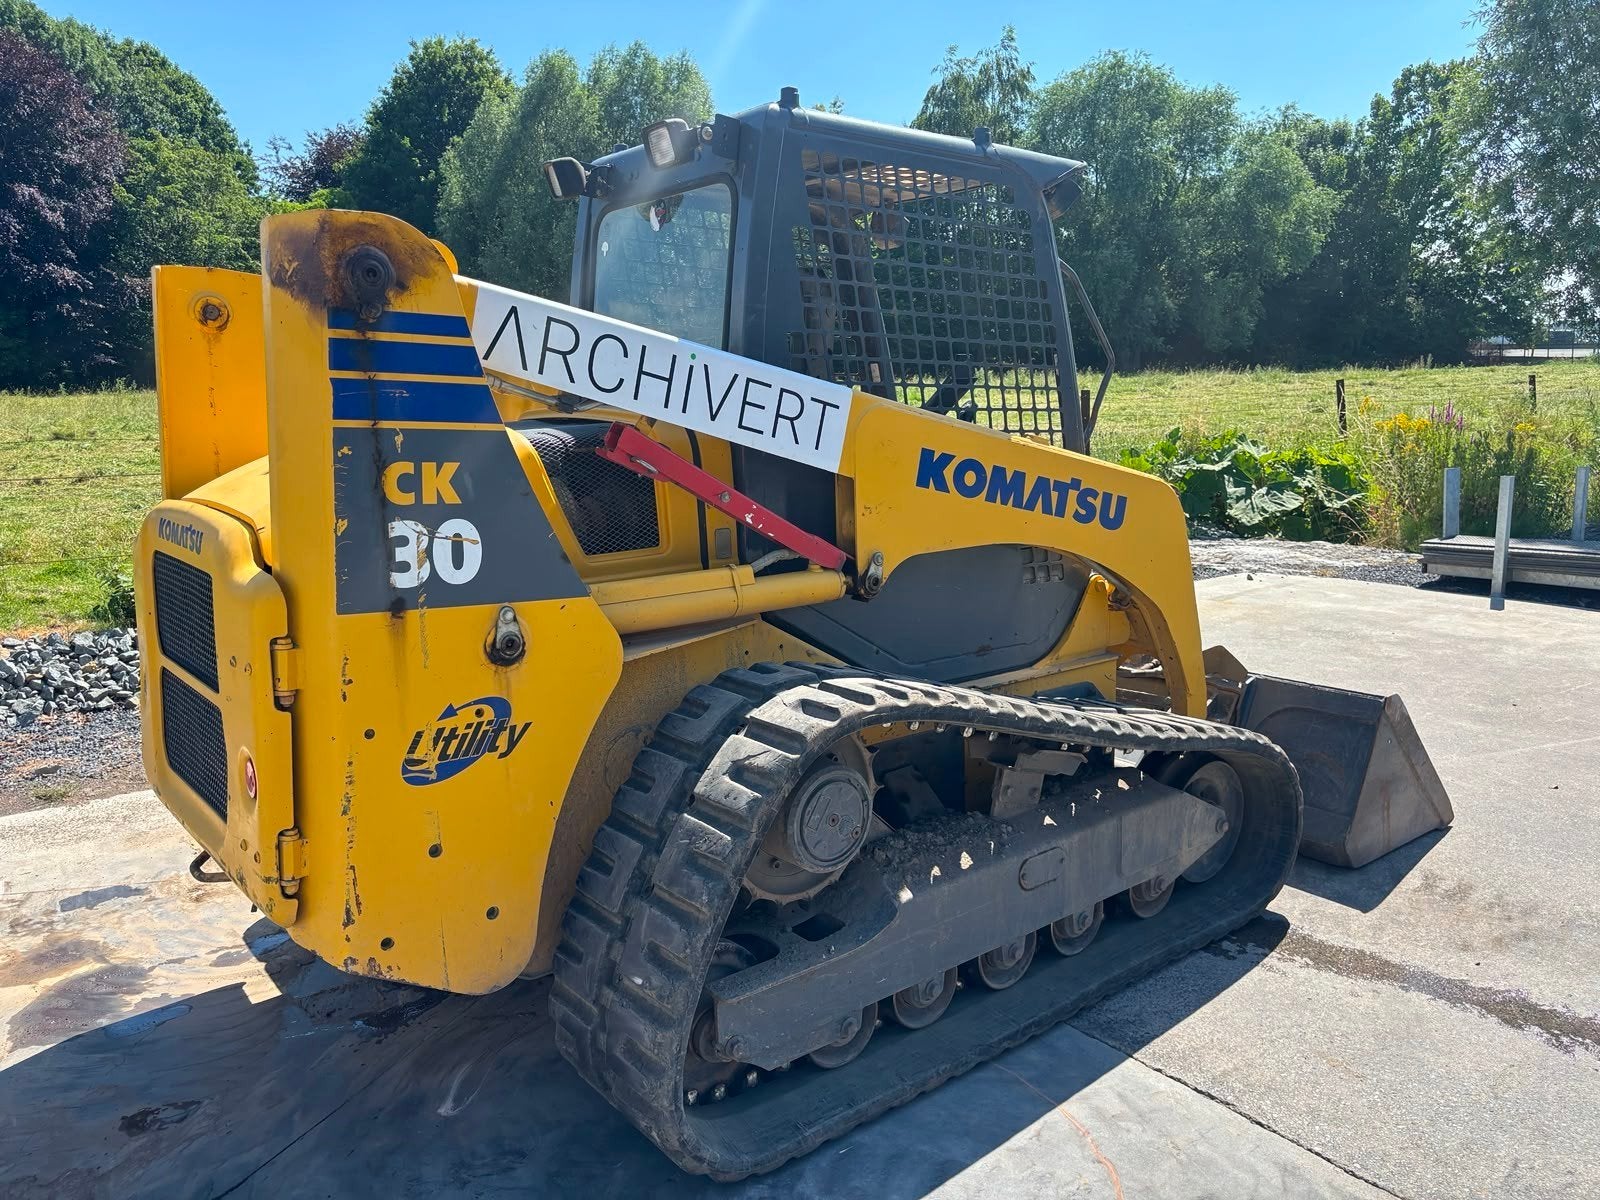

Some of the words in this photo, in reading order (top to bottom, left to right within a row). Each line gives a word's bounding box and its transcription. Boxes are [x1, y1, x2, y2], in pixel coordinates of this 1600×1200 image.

[381, 461, 463, 506] CK
[915, 447, 1128, 530] KOMATSU
[158, 517, 204, 556] KOMATSU
[388, 518, 483, 589] 30
[404, 718, 533, 767] Utility
